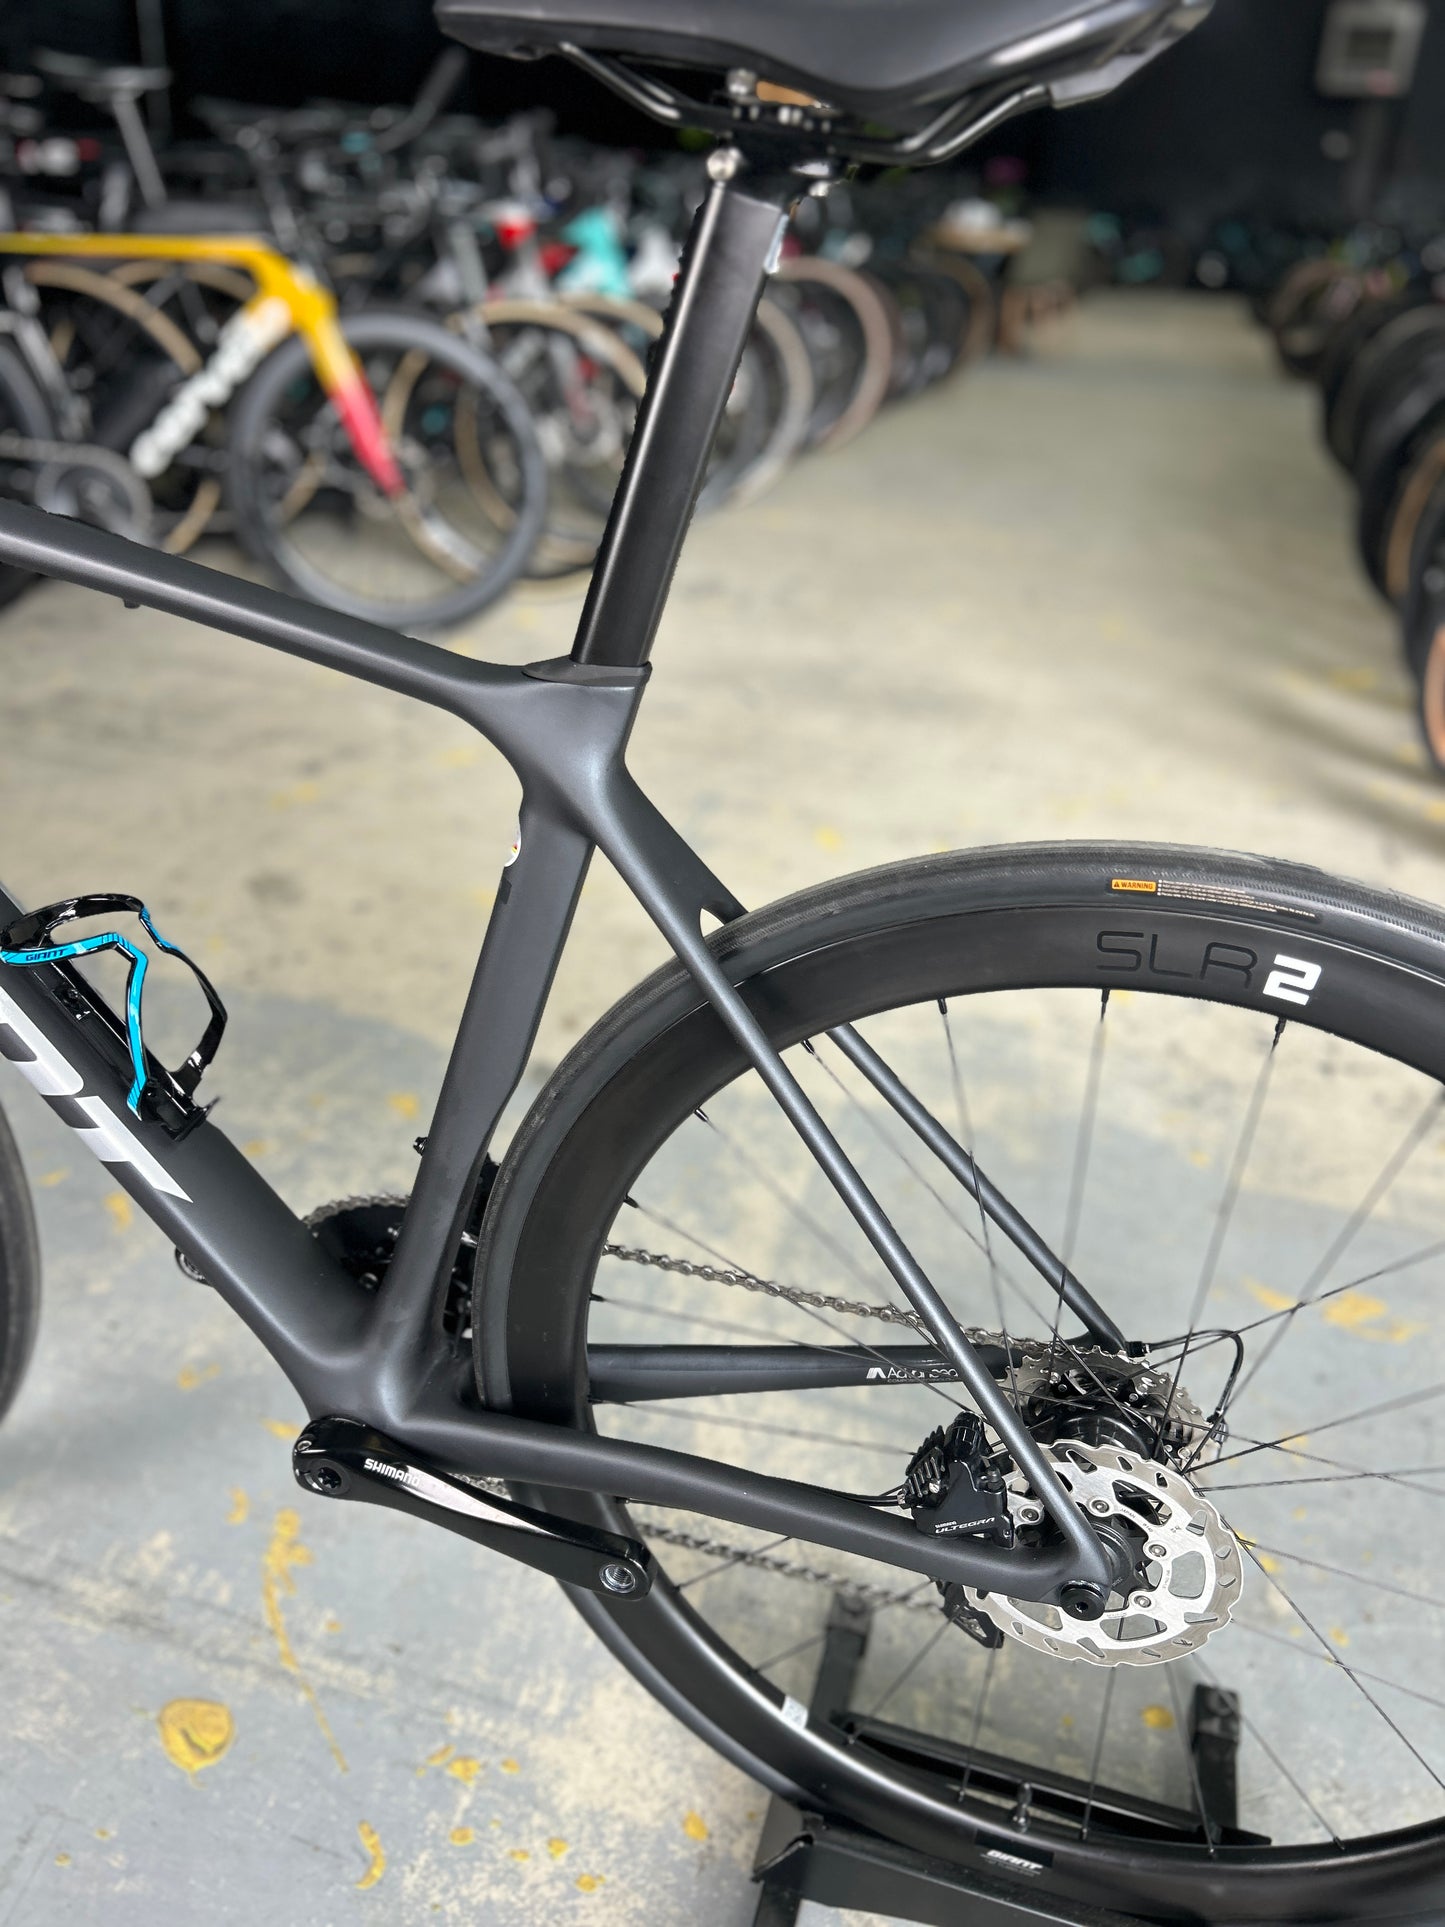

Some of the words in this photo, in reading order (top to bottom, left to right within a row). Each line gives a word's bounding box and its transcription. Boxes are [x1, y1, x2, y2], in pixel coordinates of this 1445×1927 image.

[1121, 881, 1154, 890] WARNING
[25, 947, 68, 962] GIANT
[363, 1457, 421, 1488] SHIMANO
[935, 1516, 995, 1534] ULTEGRA
